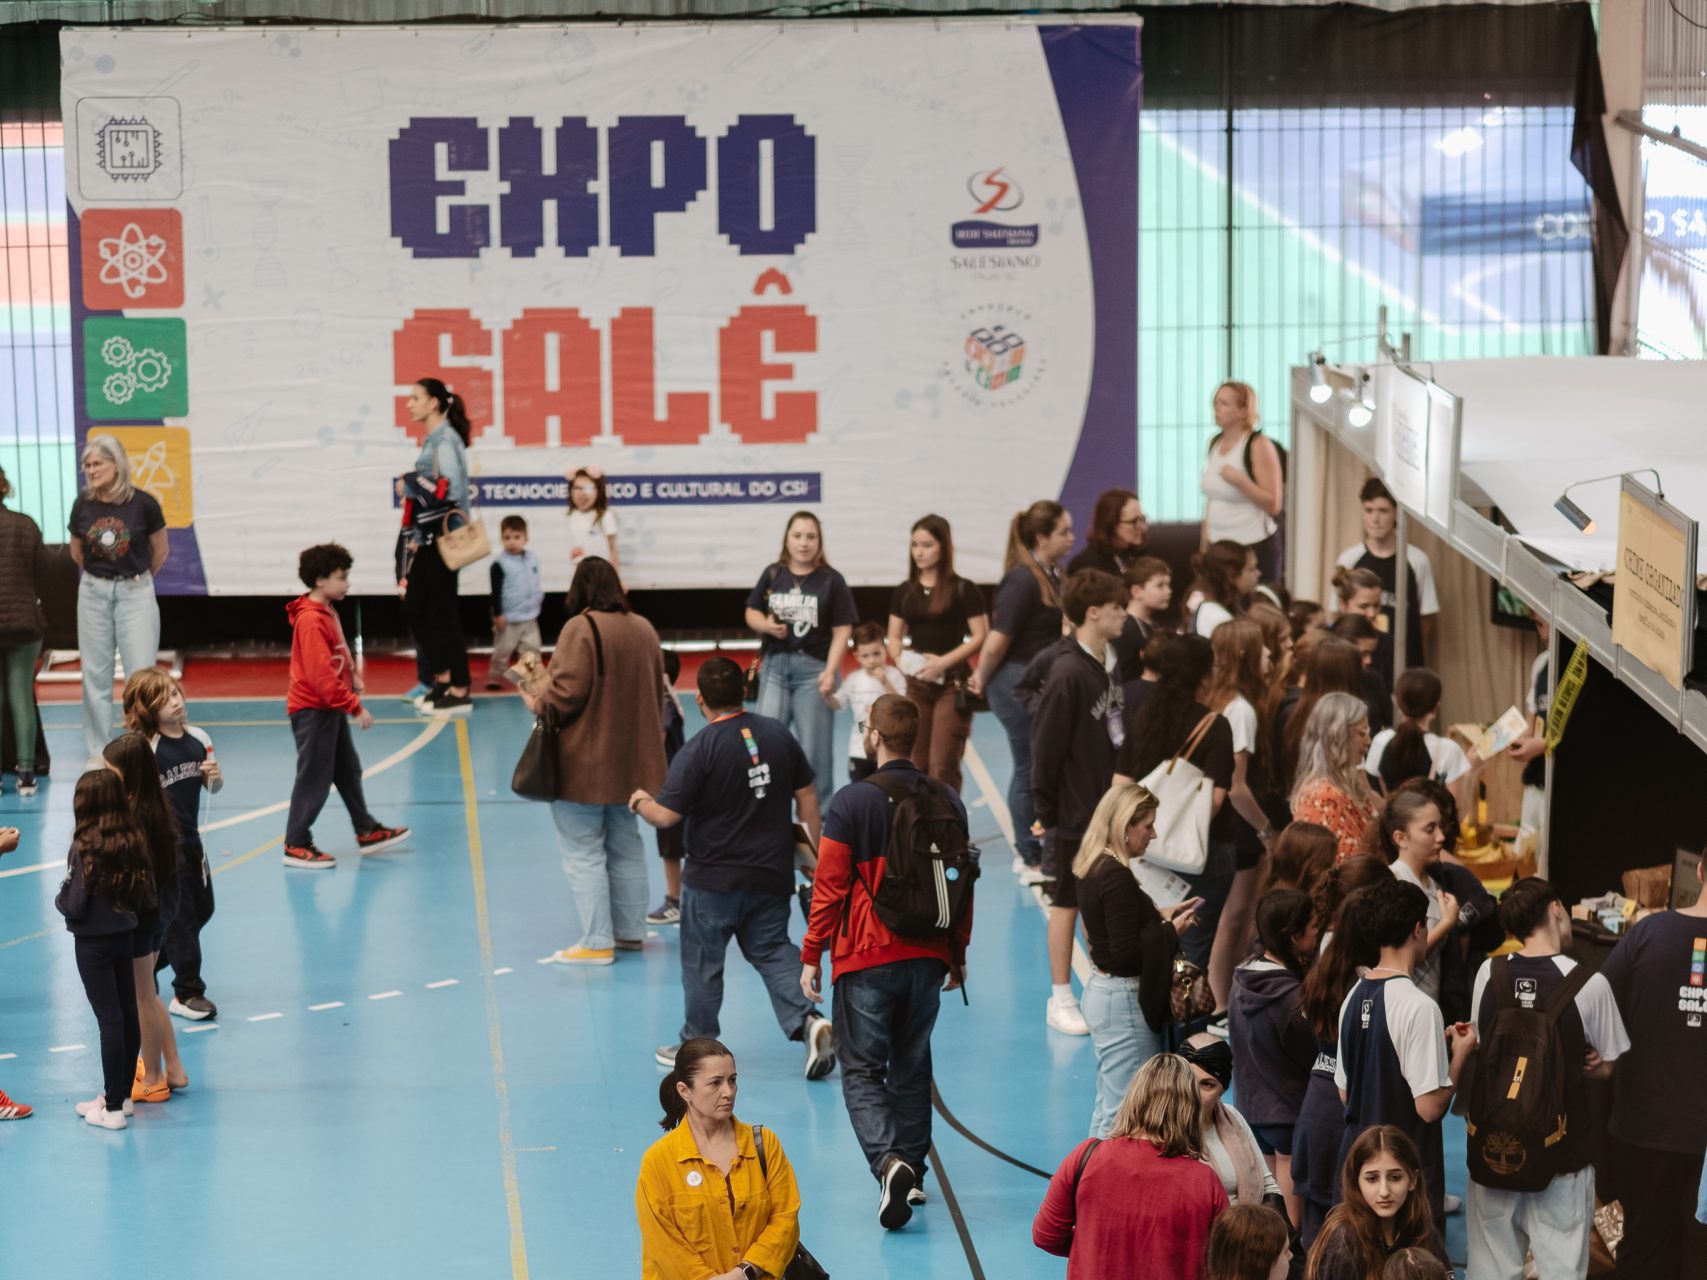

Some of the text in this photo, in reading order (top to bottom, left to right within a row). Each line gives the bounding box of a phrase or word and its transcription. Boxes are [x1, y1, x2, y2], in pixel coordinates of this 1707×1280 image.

[388, 114, 816, 258] EXPO
[393, 267, 818, 447] SALÊ
[641, 482, 654, 499] E
[656, 481, 746, 499] CULTURAL
[748, 481, 778, 497] DO
